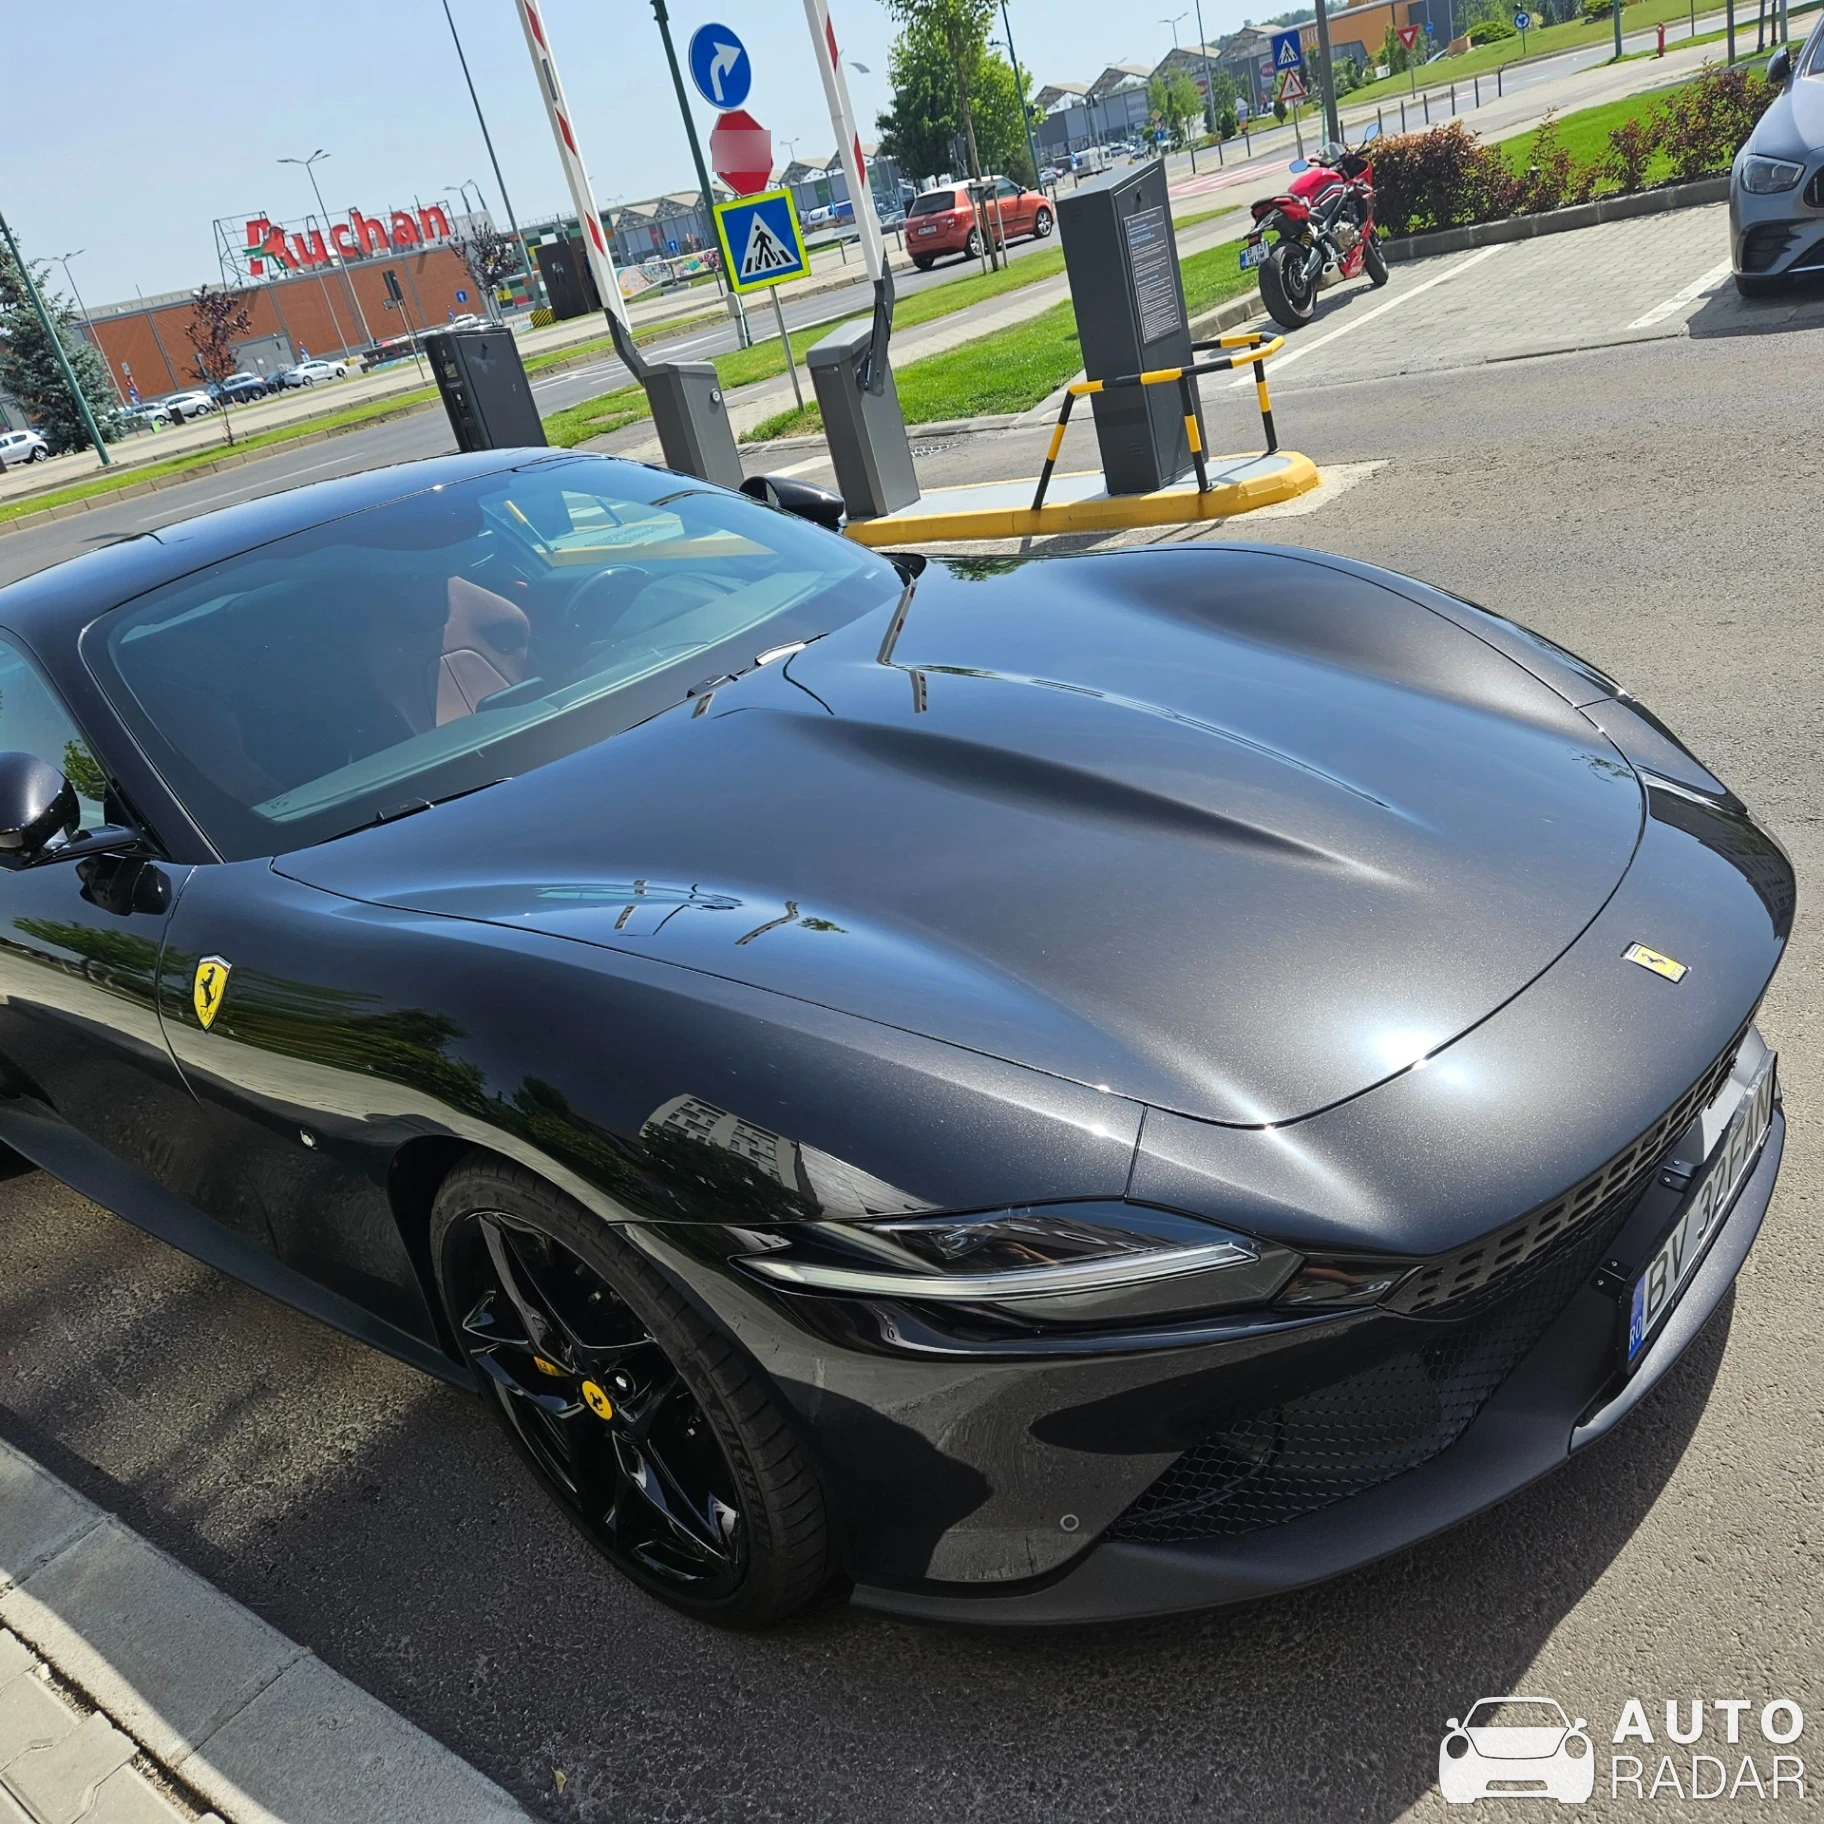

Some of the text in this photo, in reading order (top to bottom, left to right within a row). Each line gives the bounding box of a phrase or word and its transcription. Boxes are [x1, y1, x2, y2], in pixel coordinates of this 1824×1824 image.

[246, 206, 451, 276] Auchan
[1646, 1213, 1689, 1325] BV
[1697, 1156, 1727, 1240] 32
[1628, 1315, 1643, 1351] RO
